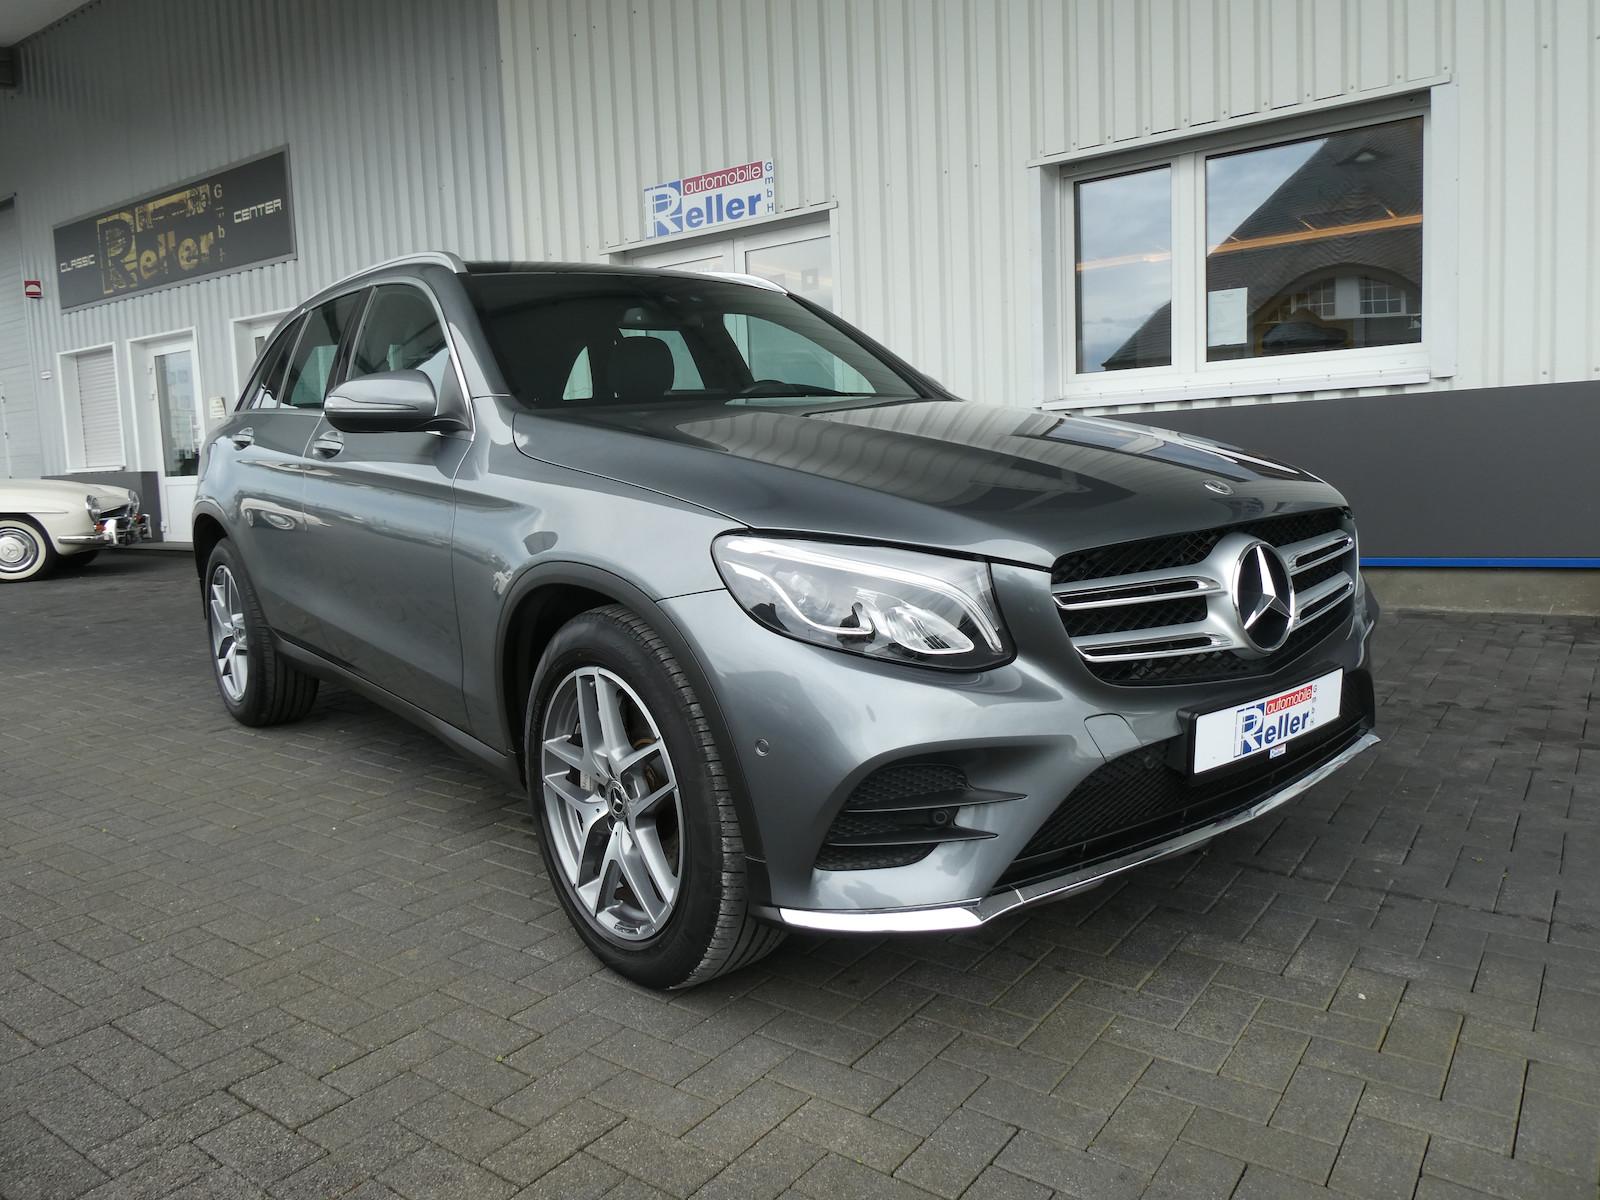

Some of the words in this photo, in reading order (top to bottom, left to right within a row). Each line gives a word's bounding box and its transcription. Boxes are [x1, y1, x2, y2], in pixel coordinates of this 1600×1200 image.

[684, 164, 762, 195] automobile
[764, 161, 774, 214] GmbH
[233, 198, 282, 224] CENTER
[644, 180, 762, 239] Reller
[1266, 686, 1312, 715] automobile
[1233, 702, 1310, 758] Reller
